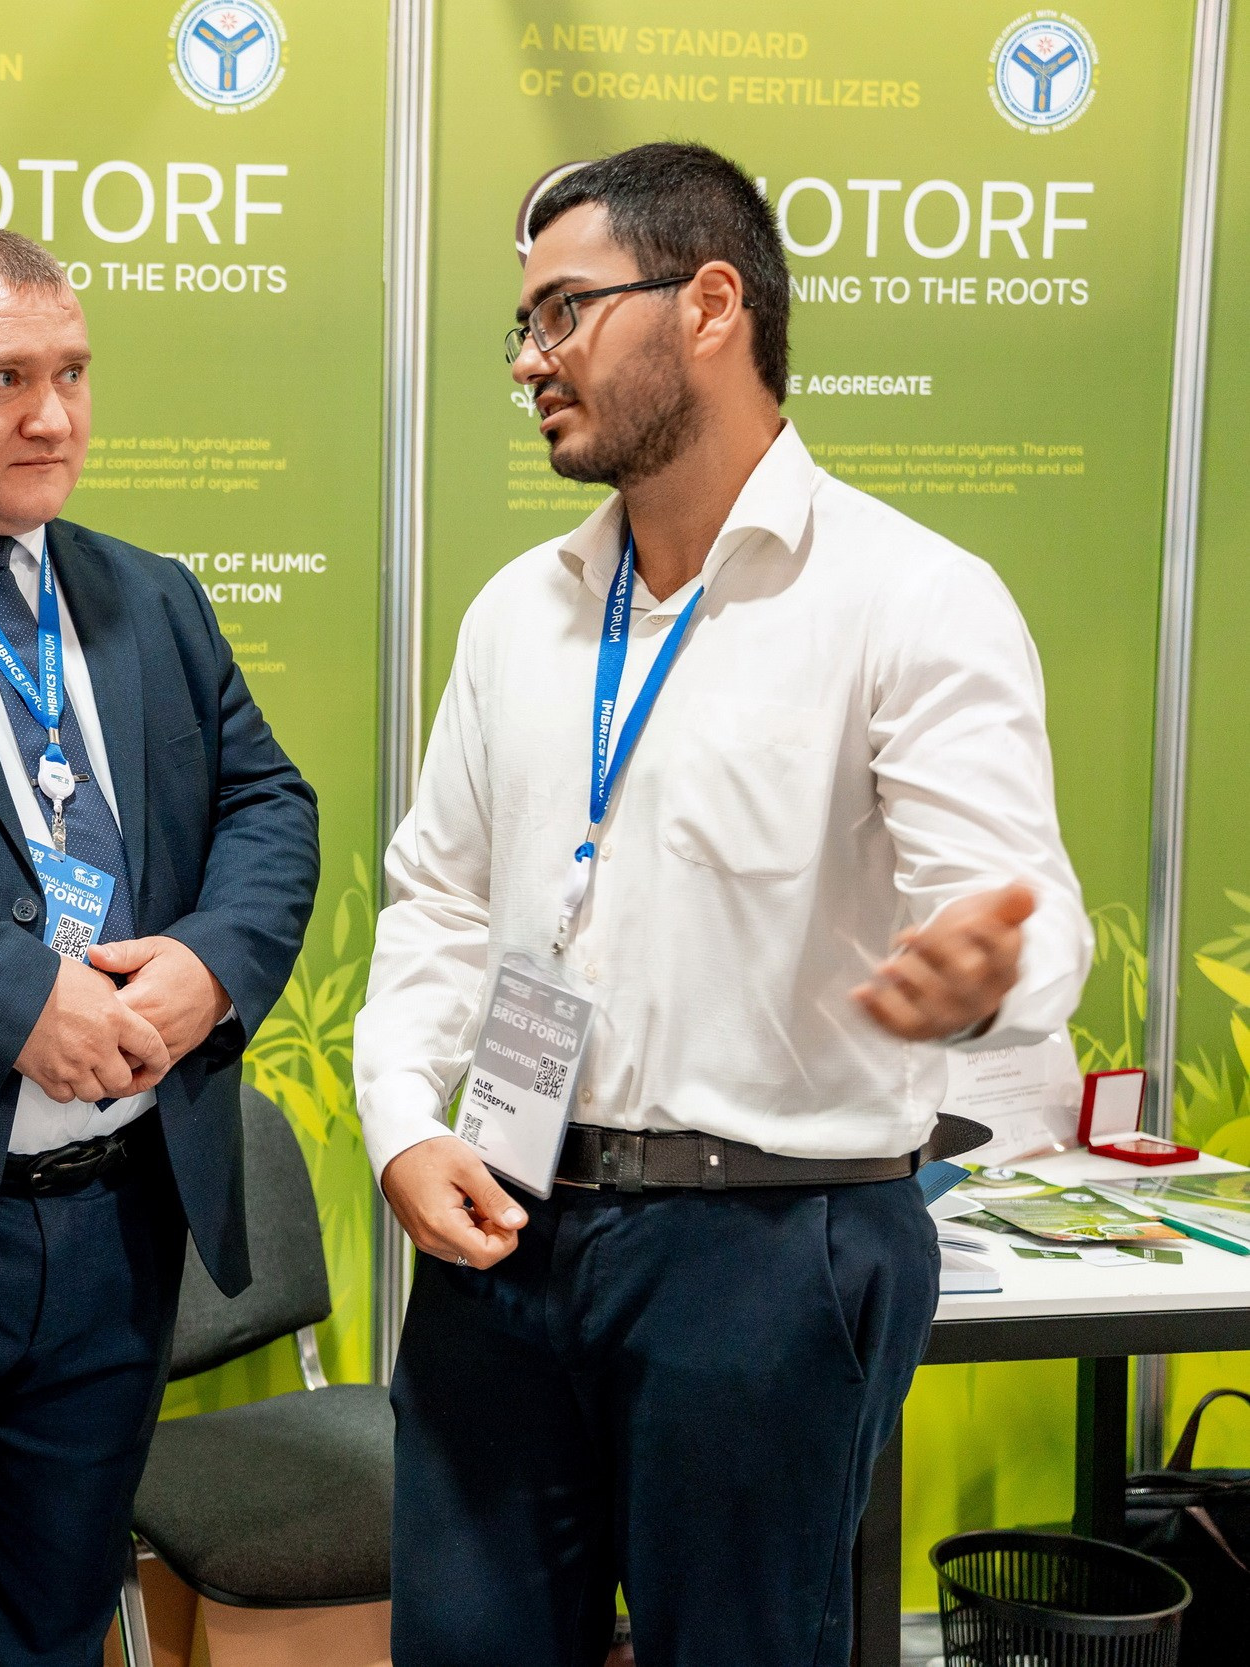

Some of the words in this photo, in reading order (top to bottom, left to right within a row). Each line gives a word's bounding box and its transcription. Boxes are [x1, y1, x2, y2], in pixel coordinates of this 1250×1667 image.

[521, 23, 543, 51] A
[553, 25, 628, 53] NEW
[636, 28, 809, 60] STANDARD
[519, 69, 563, 97] OF
[572, 71, 719, 102] ORGANIC
[728, 76, 921, 108] FERTILIZERS
[100, 262, 165, 291] THE
[175, 264, 288, 293] ROOTS
[869, 276, 911, 304] TO
[918, 277, 978, 305] THE
[986, 278, 1089, 306] ROOTS
[806, 375, 933, 396] AGGREGATE
[109, 438, 136, 450] and
[139, 437, 180, 453] easily
[182, 438, 272, 454] hydrolyzable
[827, 444, 892, 460] properties
[895, 444, 910, 458] to
[912, 444, 955, 458] natural
[1022, 442, 1046, 458] The
[1048, 446, 1085, 460] pores
[105, 458, 189, 473] composition
[192, 457, 208, 471] of
[211, 457, 233, 471] the
[236, 458, 287, 472] mineral
[835, 461, 856, 475] the
[859, 462, 902, 476] normal
[905, 462, 976, 478] functioning
[979, 462, 993, 476] of
[995, 462, 1035, 478] plants
[1037, 462, 1060, 476] and
[1063, 462, 1085, 476] soil
[133, 477, 188, 491] content
[190, 476, 205, 490] of
[208, 478, 260, 493] organic
[909, 482, 923, 495] of
[926, 482, 956, 495] their
[508, 499, 550, 512] which
[213, 552, 247, 573] OF
[251, 553, 328, 574] HUMIC
[608, 602, 625, 643] FORUM
[45, 634, 55, 673] FORUM
[47, 670, 57, 717] IMBRICS
[598, 699, 615, 761] IMBRICS
[44, 882, 103, 917] FORUM
[61, 882, 104, 905] MUNICIPAL
[491, 1005, 528, 1032] BRICS
[528, 1020, 579, 1053] FORUM
[484, 1038, 539, 1072] VOLUNTEER
[474, 1077, 494, 1093] ALEK
[472, 1086, 517, 1116] HOVSEPYAN
